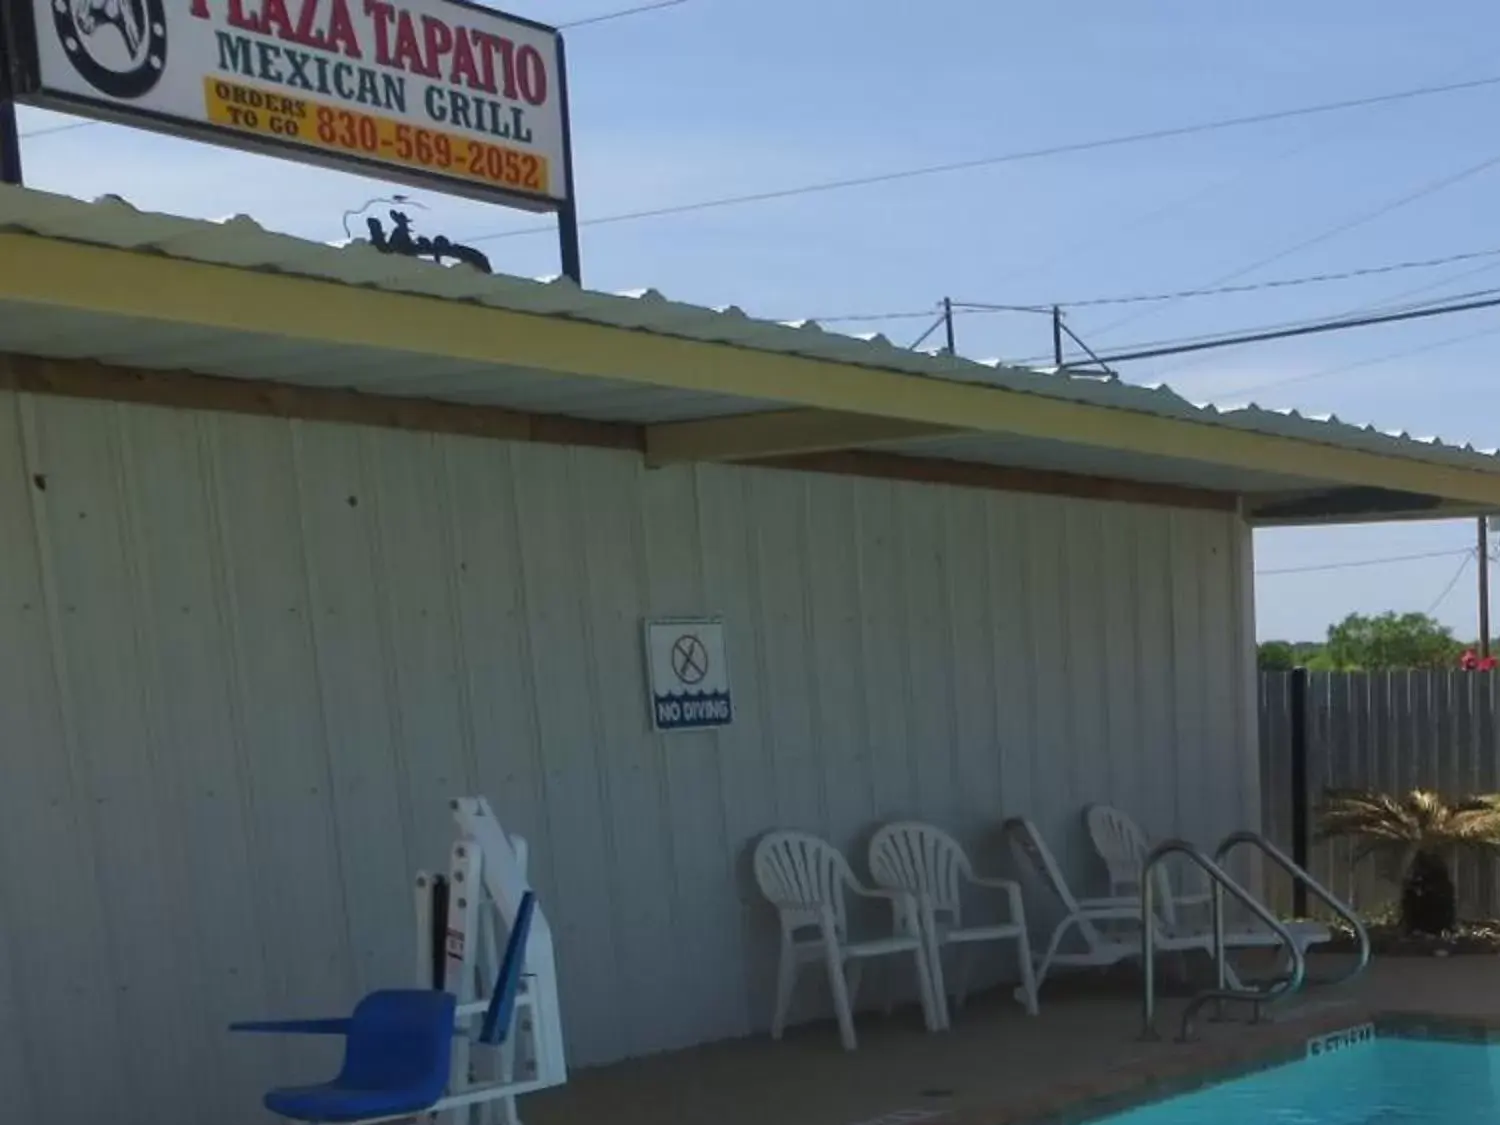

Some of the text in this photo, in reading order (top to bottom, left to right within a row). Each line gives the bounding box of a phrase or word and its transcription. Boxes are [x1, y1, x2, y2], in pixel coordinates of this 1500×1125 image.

[189, 0, 548, 106] LAZA TAPATIO
[214, 29, 533, 144] MEXICAN GRILL
[214, 82, 307, 119] ORDERS
[226, 105, 300, 137] TO GO
[316, 105, 541, 189] 830-569-2052
[657, 700, 730, 722] NO DIVING
